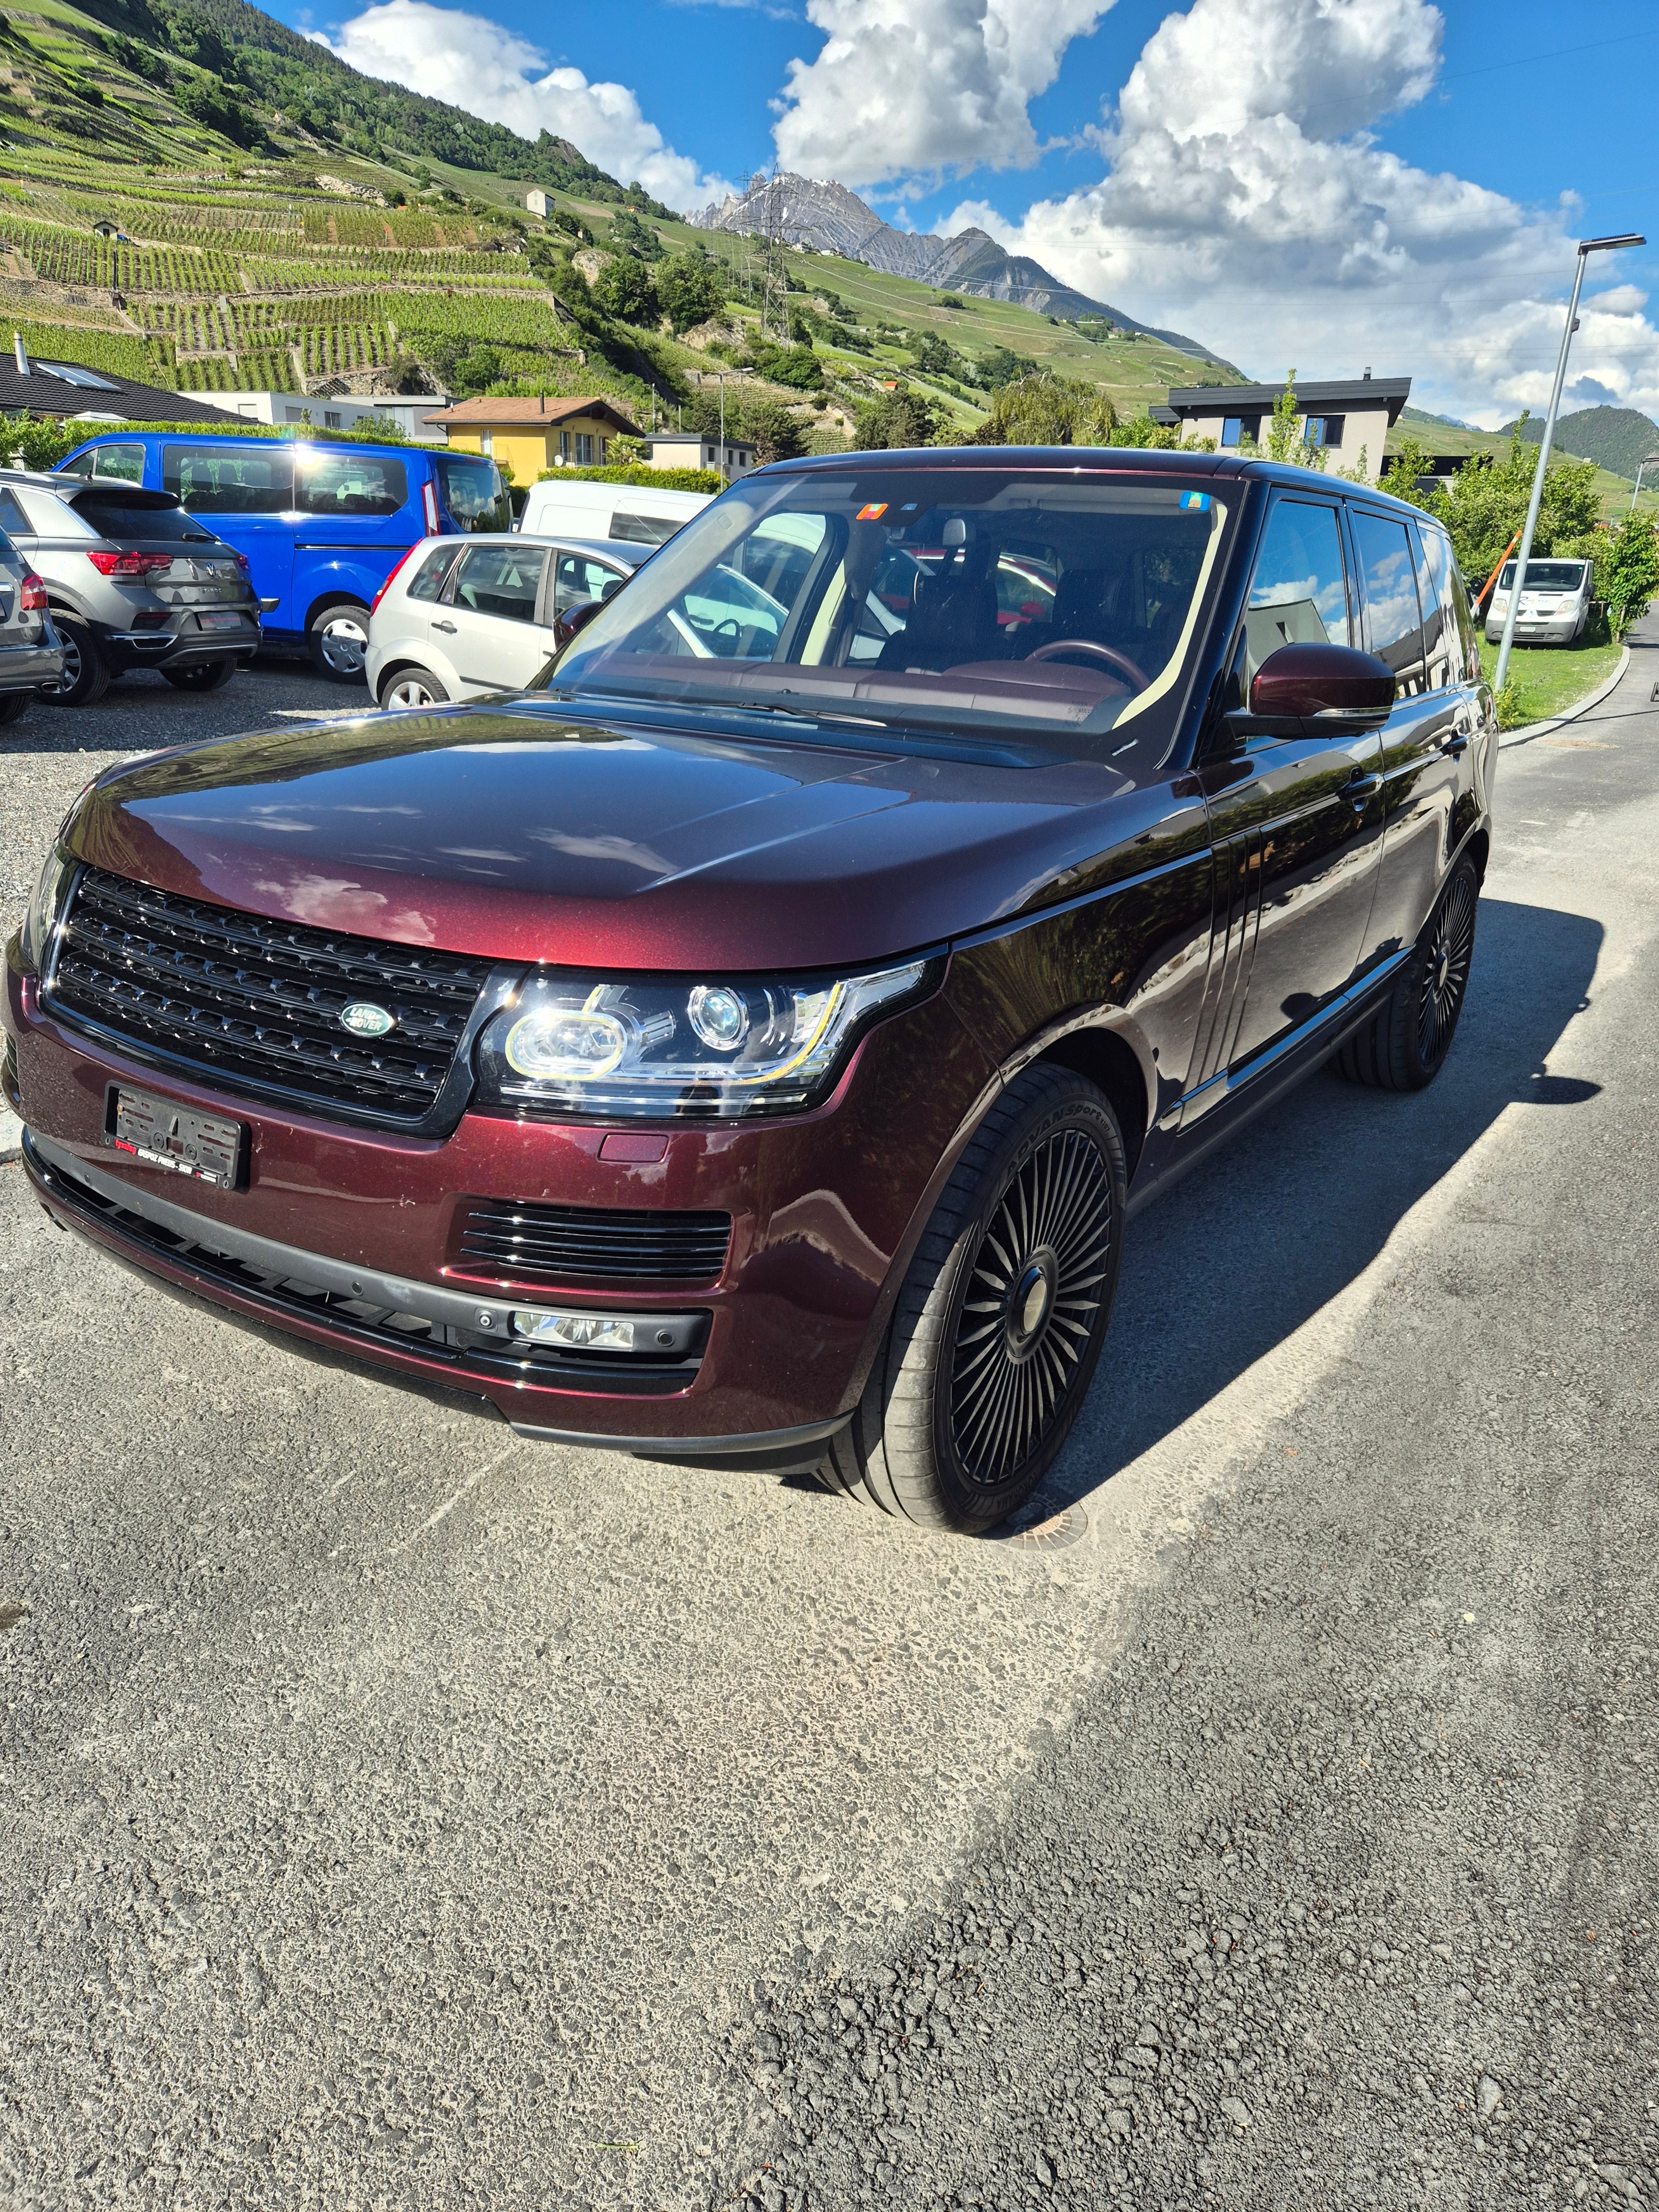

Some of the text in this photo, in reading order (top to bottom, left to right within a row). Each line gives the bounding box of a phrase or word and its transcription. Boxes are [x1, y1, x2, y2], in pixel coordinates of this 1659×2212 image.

[350, 1007, 377, 1020] LAND
[349, 1018, 382, 1031] ROVER
[1065, 1104, 1102, 1121] Sport
[138, 1148, 159, 1162] GASPOZ
[158, 1156, 176, 1169] PNEUS
[178, 1164, 193, 1175] SION
